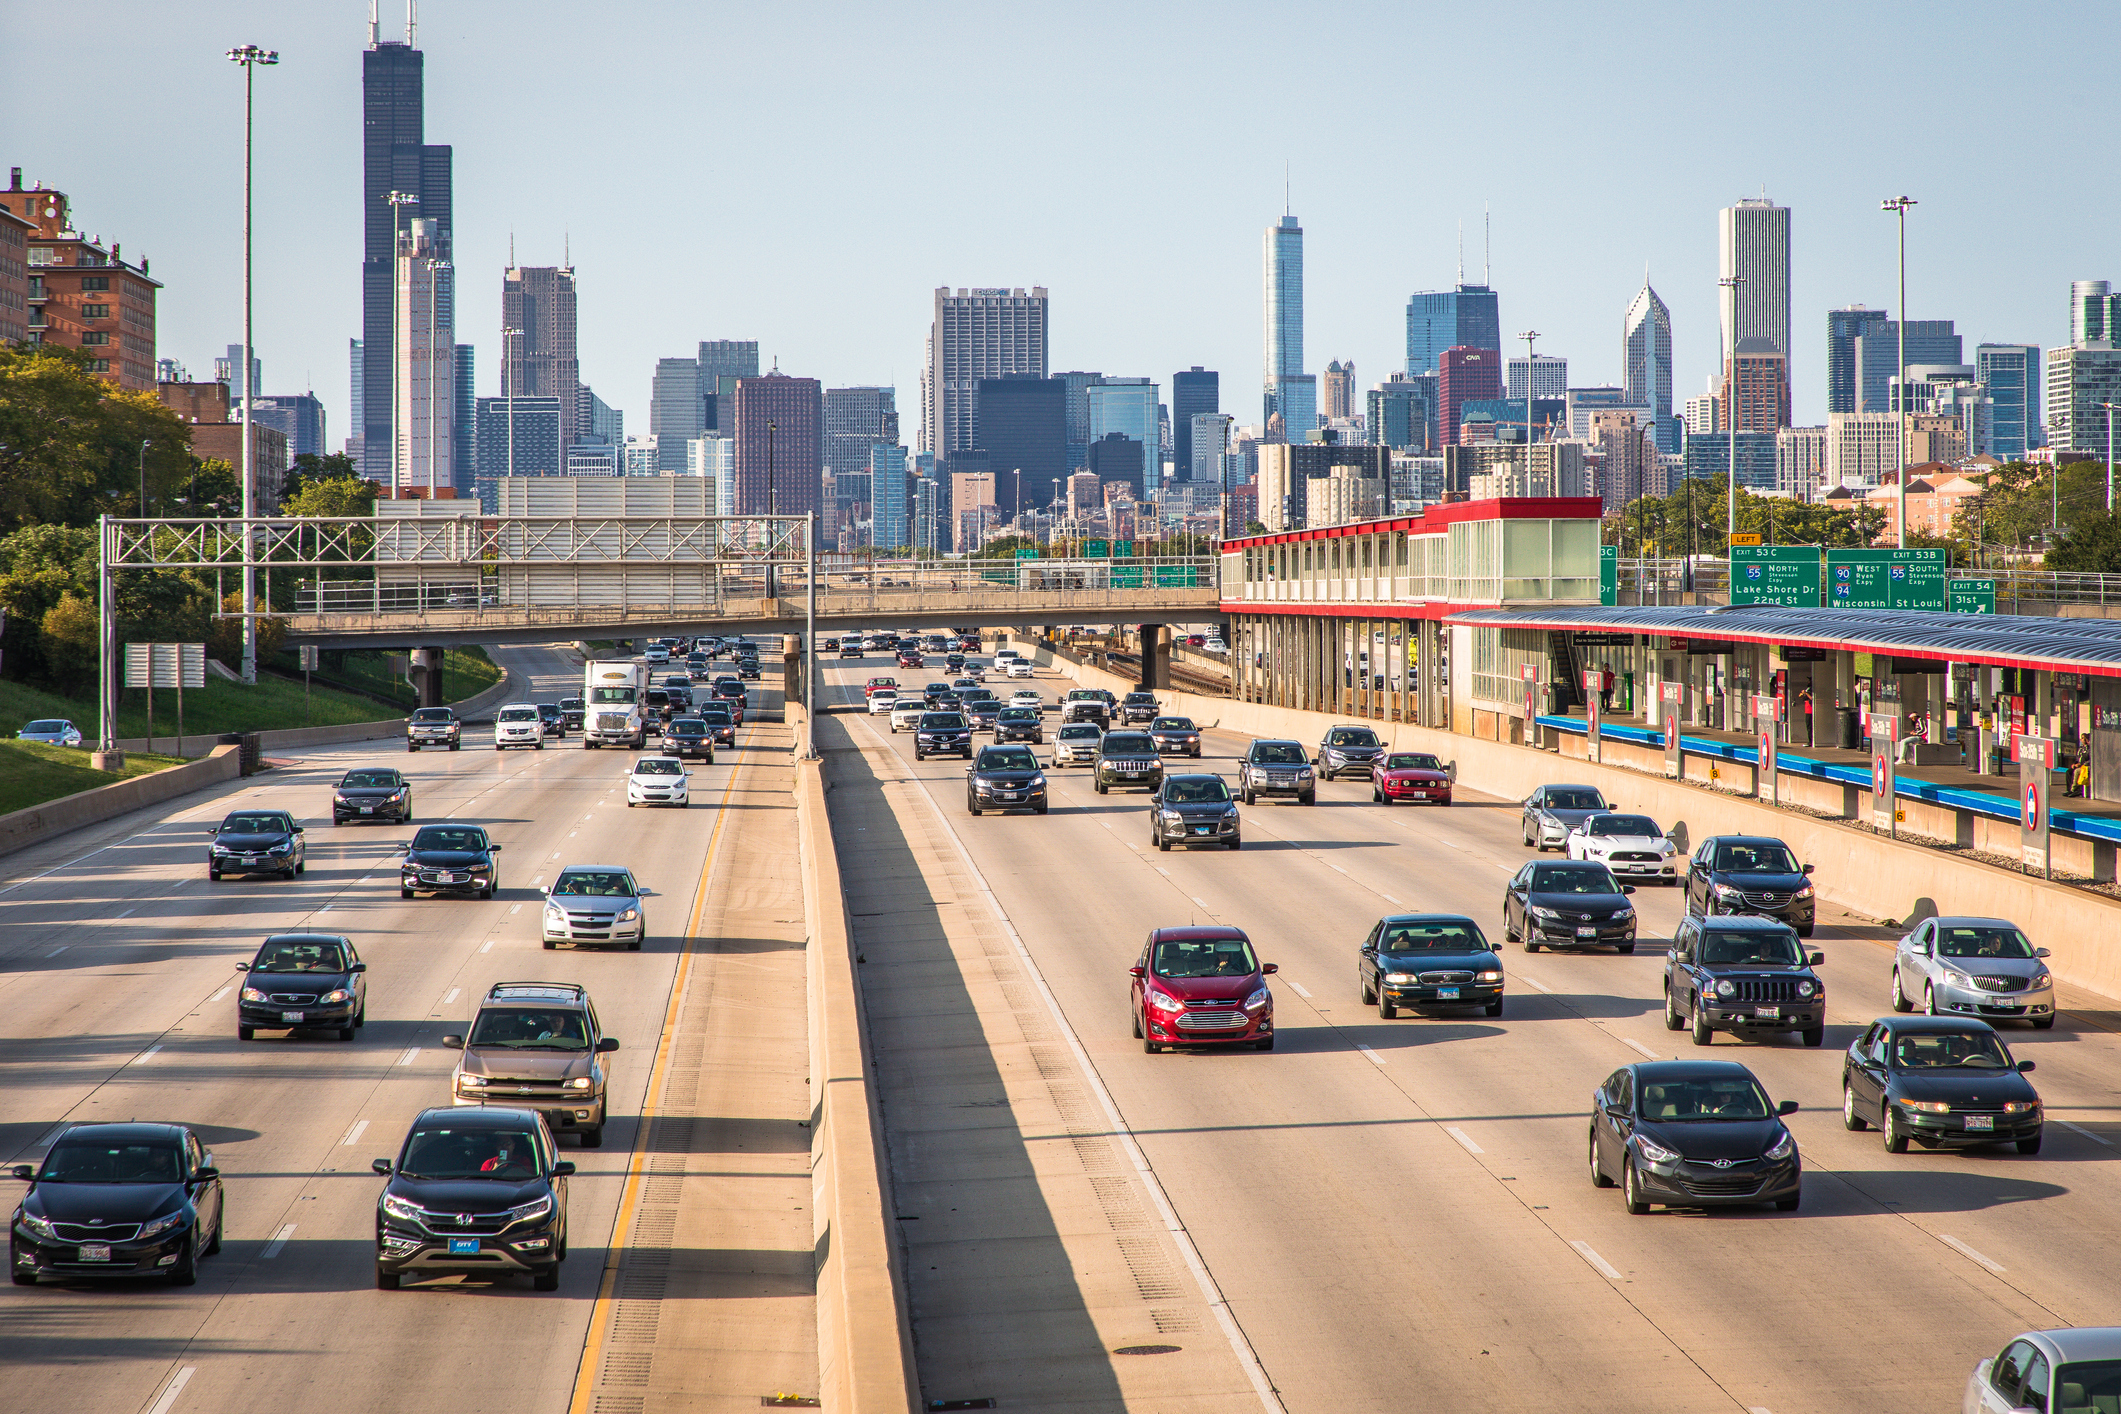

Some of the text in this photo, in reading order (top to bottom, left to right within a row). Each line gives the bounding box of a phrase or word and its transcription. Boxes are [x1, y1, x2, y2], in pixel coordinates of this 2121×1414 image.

[1748, 568, 1760, 577] 55
[1837, 569, 1849, 578] 90
[1892, 569, 1904, 578] 55
[1736, 585, 1815, 593] Lake Shore Dr
[1836, 586, 1849, 594] 94
[1976, 582, 1990, 590] 54
[1754, 596, 1797, 604] 22nd St
[1833, 599, 1885, 607] Wisconsin
[1896, 599, 1942, 607] St Louis
[1712, 770, 1718, 778] 8
[1896, 812, 1903, 821] 6
